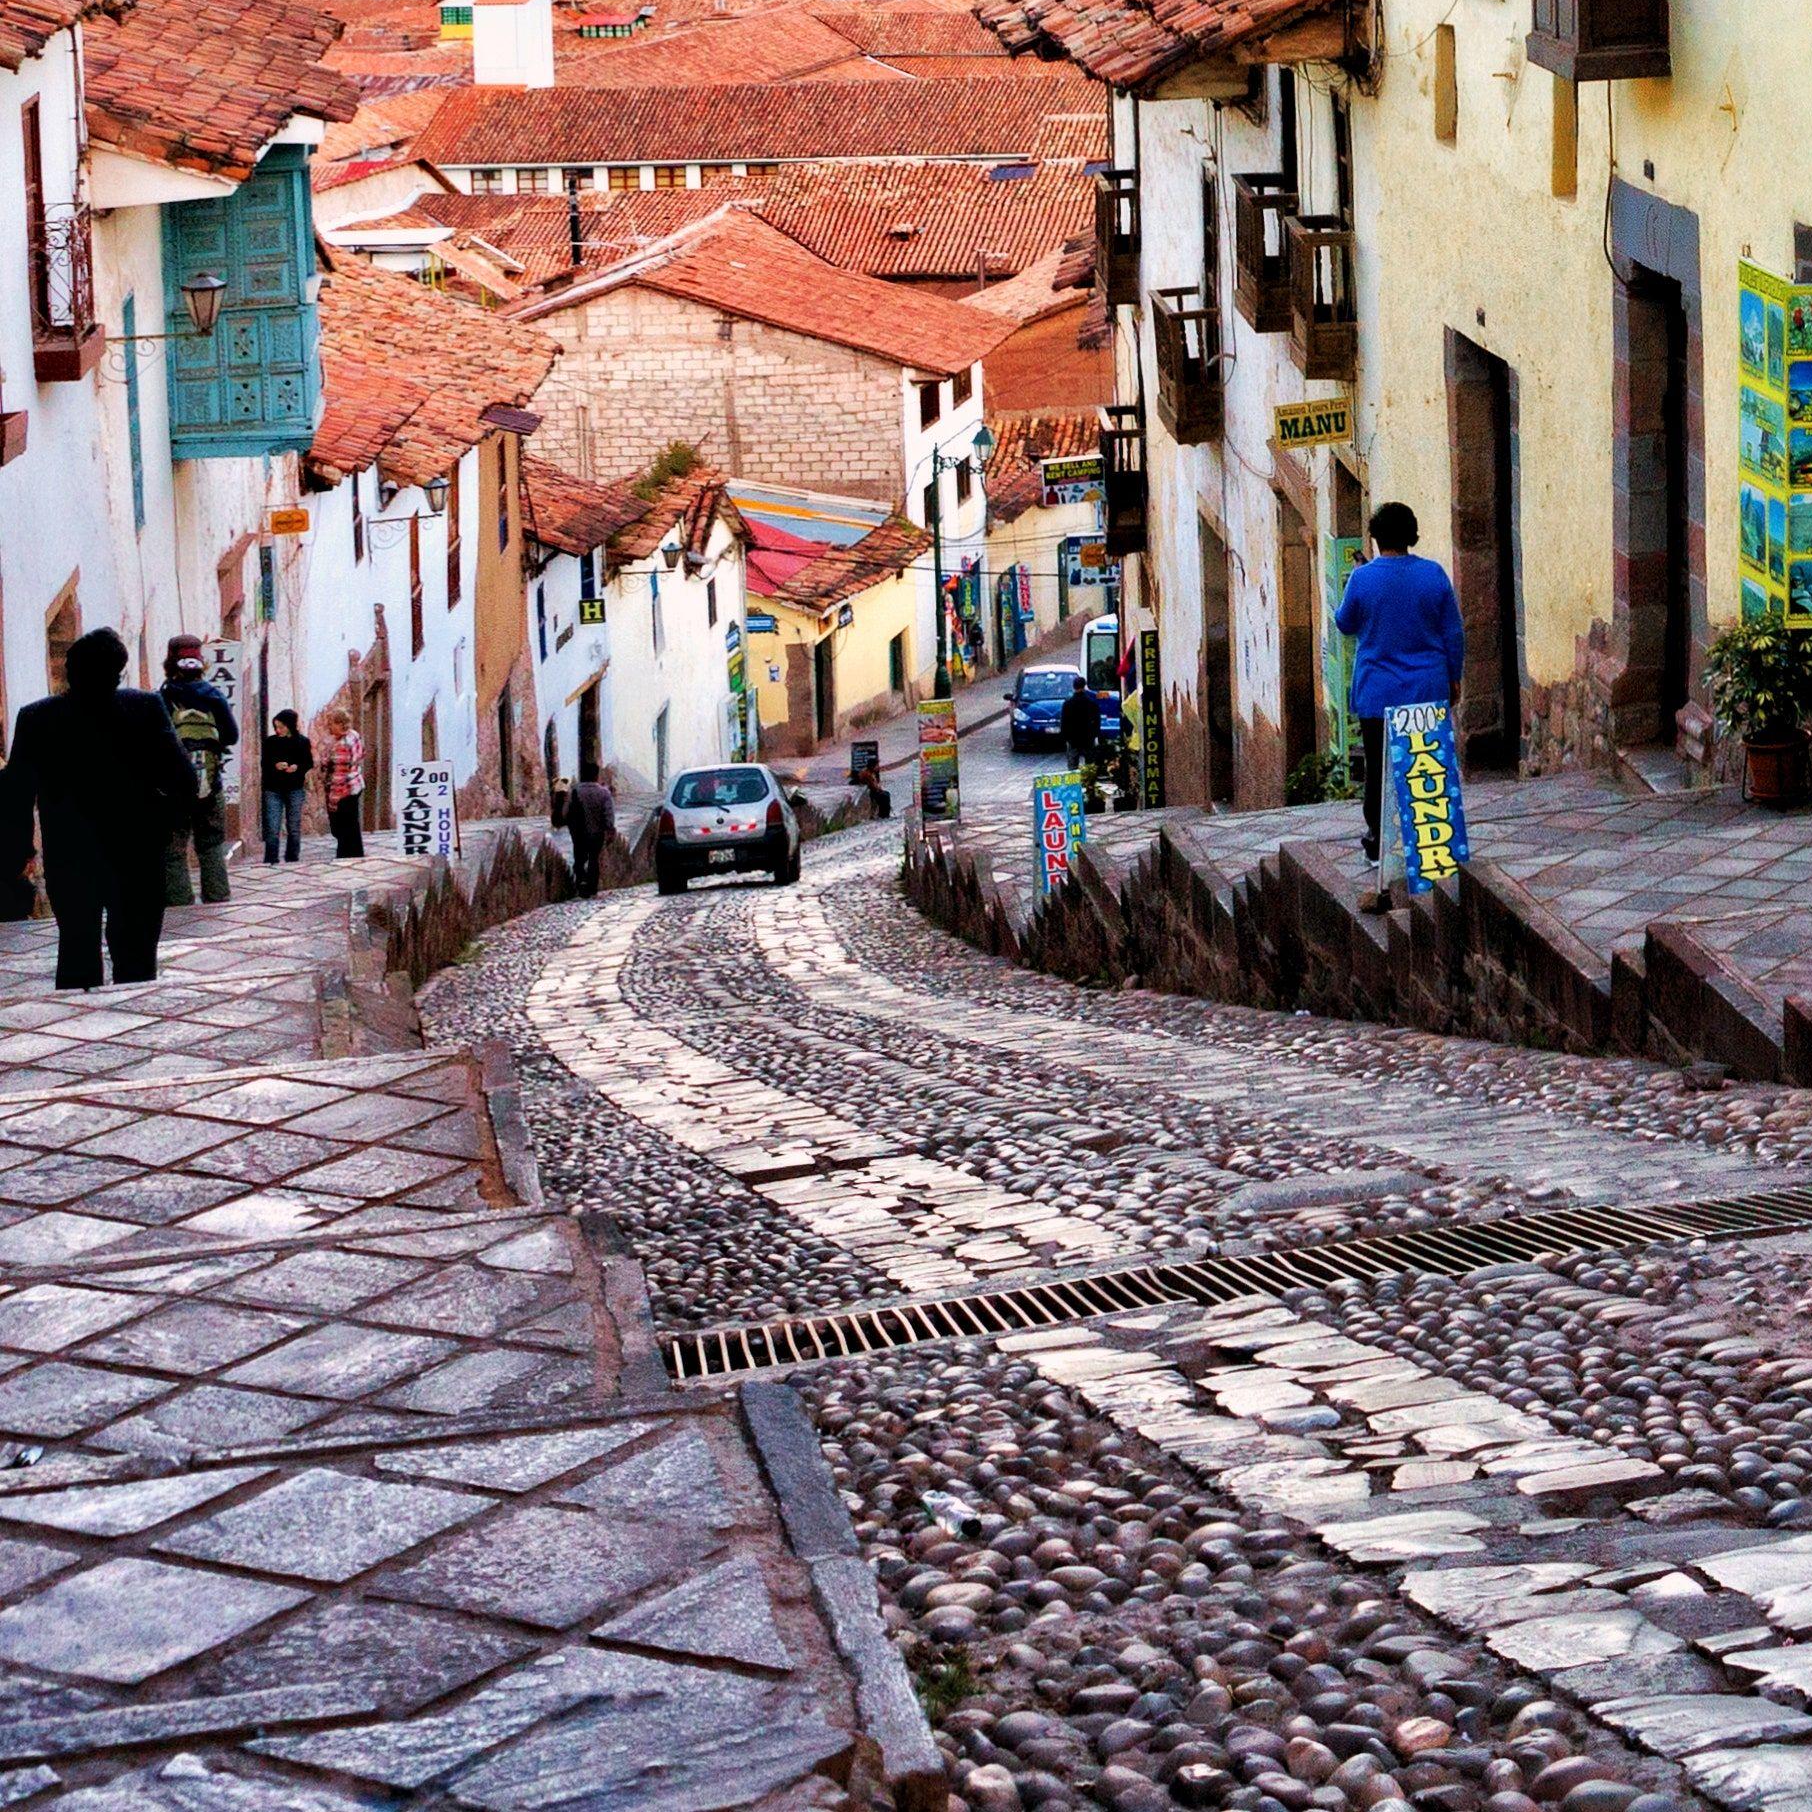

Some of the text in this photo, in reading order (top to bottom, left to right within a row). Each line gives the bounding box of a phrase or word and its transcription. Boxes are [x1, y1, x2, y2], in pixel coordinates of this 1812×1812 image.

[1279, 411, 1346, 440] MANU
[1062, 461, 1080, 470] SELL
[1081, 459, 1098, 468] AND
[582, 601, 603, 620] H
[1145, 634, 1156, 686] FREE
[1145, 701, 1160, 805] INFORMAT
